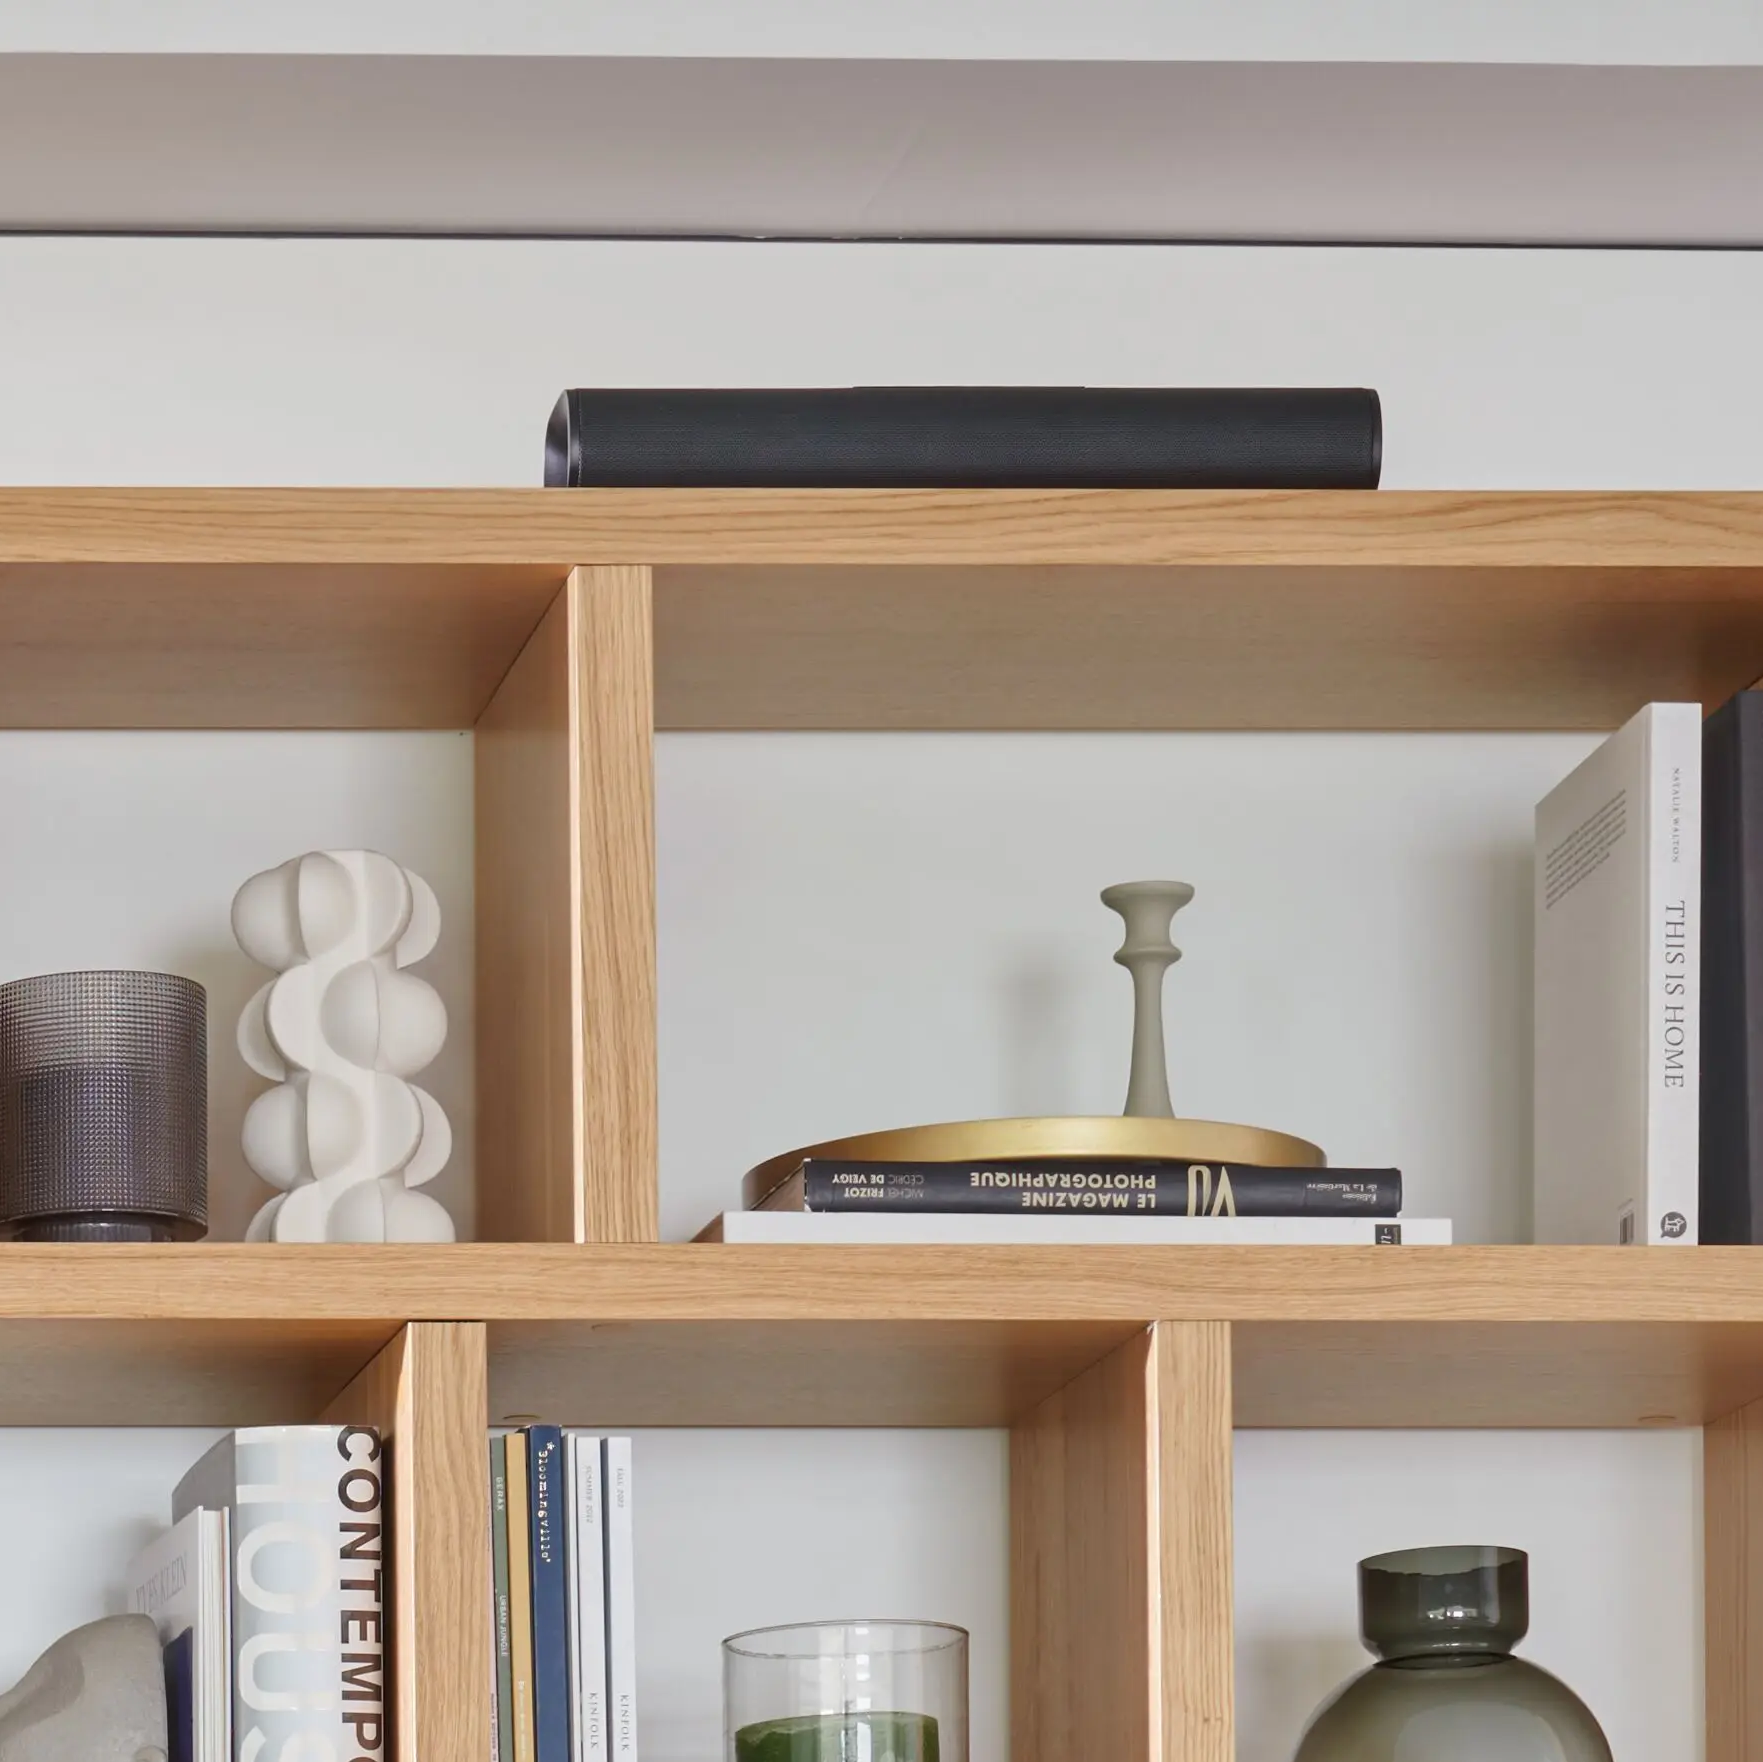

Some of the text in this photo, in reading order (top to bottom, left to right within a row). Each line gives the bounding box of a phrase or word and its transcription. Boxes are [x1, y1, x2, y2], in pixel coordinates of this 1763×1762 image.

[1671, 767, 1681, 863] NATALIE WALTON
[1663, 900, 1686, 1089] THIS IS HOME
[843, 1187, 884, 1198] FRIZOT
[870, 1174, 885, 1185] DE
[969, 1170, 1157, 1191] PHOTOGRAPHIQUE
[1021, 1191, 1157, 1208] LE MAGAZINE
[588, 1692, 599, 1750] KINFOLK
[620, 1693, 630, 1752] KINFOLK
